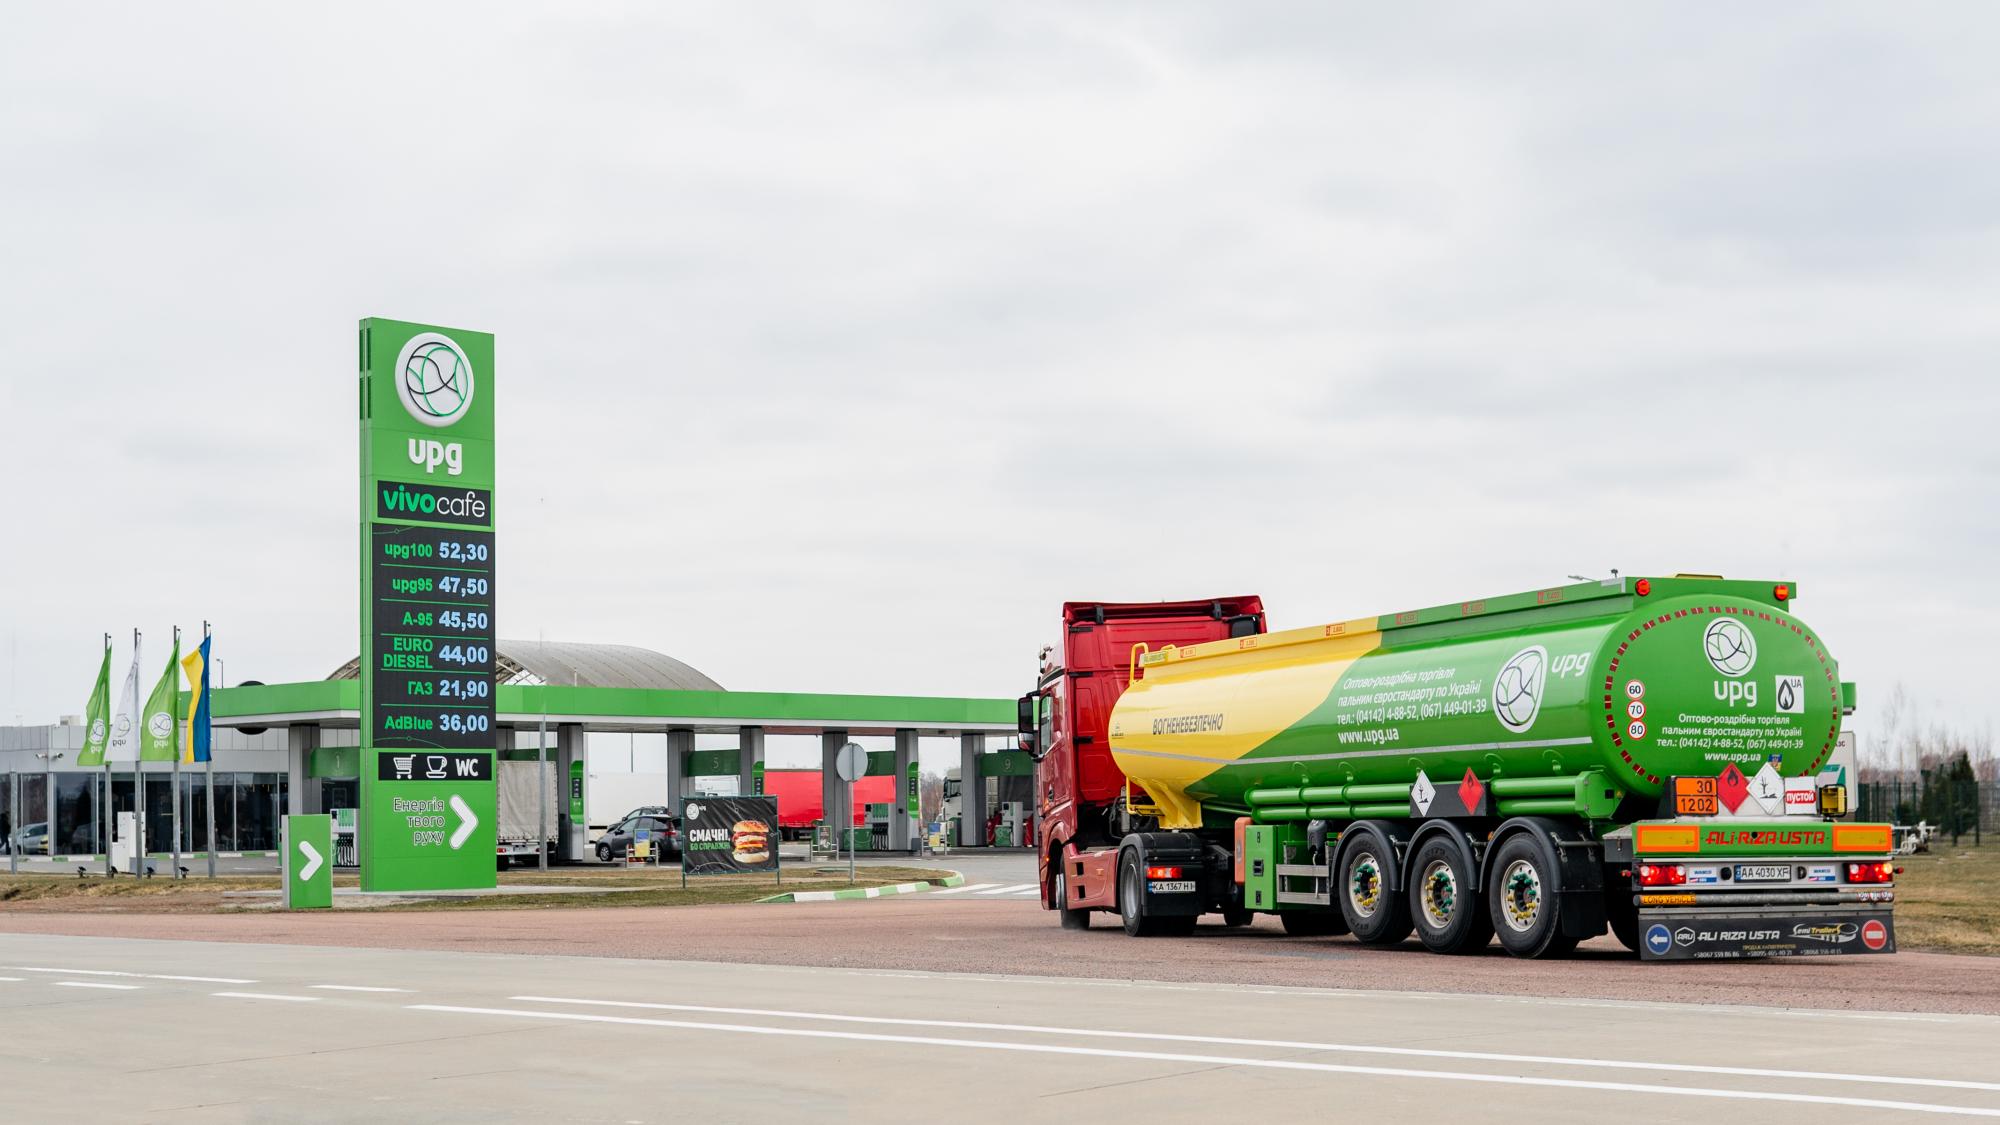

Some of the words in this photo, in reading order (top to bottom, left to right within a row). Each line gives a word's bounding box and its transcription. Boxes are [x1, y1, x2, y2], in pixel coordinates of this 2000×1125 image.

[408, 438, 463, 476] upg
[383, 485, 485, 517] vivocafe
[384, 543, 433, 560] upg100
[438, 541, 488, 563] 52,30
[392, 577, 433, 594] upg95
[438, 575, 488, 597] 47,50
[402, 611, 433, 626] A-95
[438, 610, 488, 632] 45,50
[393, 637, 433, 652] EURO
[383, 653, 433, 669] DIESEL
[438, 645, 488, 666] 44,00
[1551, 652, 1591, 678] upg
[407, 681, 433, 695] ГАЗ
[438, 679, 488, 701] 21,90
[1629, 685, 1641, 695] 60
[1790, 679, 1803, 689] UA
[1337, 694, 1374, 707] пальним
[1435, 686, 1448, 698] по
[1447, 680, 1482, 699] Україні
[1713, 680, 1757, 707] upg
[1356, 706, 1385, 726] (04142)
[1386, 704, 1419, 721] 4-88-52,
[1421, 702, 1442, 721] (067)
[1443, 698, 1487, 716] 449-01-39
[1630, 705, 1643, 715] 70
[384, 715, 433, 730] AdBlue
[438, 713, 488, 735] 36,00
[1152, 713, 1224, 736] ВОГНЕНЕБЕЗПЕЧНО
[1678, 713, 1756, 726] Оптово-роздрібна
[1757, 714, 1790, 727] торгівля
[1337, 727, 1400, 745] www.upg.ua
[1630, 725, 1644, 735] 80
[1662, 727, 1701, 735] пальним
[1702, 728, 1764, 739] євростандарту
[1764, 729, 1775, 737] по
[1775, 727, 1803, 738] Україні
[1679, 737, 1711, 750] (04142)
[1713, 738, 1745, 749] 4-88-52,
[1746, 739, 1767, 750] (067)
[1767, 739, 1804, 749] 449-01-39
[713, 756, 719, 769] 5
[1004, 758, 1011, 770] 9
[1704, 753, 1762, 764] www.upg.ua
[455, 758, 479, 777] WC
[1696, 779, 1713, 794] 30
[1786, 790, 1815, 804] пустой
[393, 796, 445, 815] Енергія
[1680, 798, 1714, 813] 1202
[406, 816, 445, 828] твого
[413, 831, 445, 846] руху
[1779, 831, 1825, 845] USTA
[1741, 867, 1754, 878] AA
[1755, 867, 1776, 878] 4030
[1166, 882, 1181, 891] 1367
[1643, 895, 1663, 904] LONG
[1665, 894, 1695, 903] VEHICLE
[1697, 931, 1718, 941] ALI
[1719, 931, 1746, 940] RIZA
[1748, 930, 1780, 940] USTA
